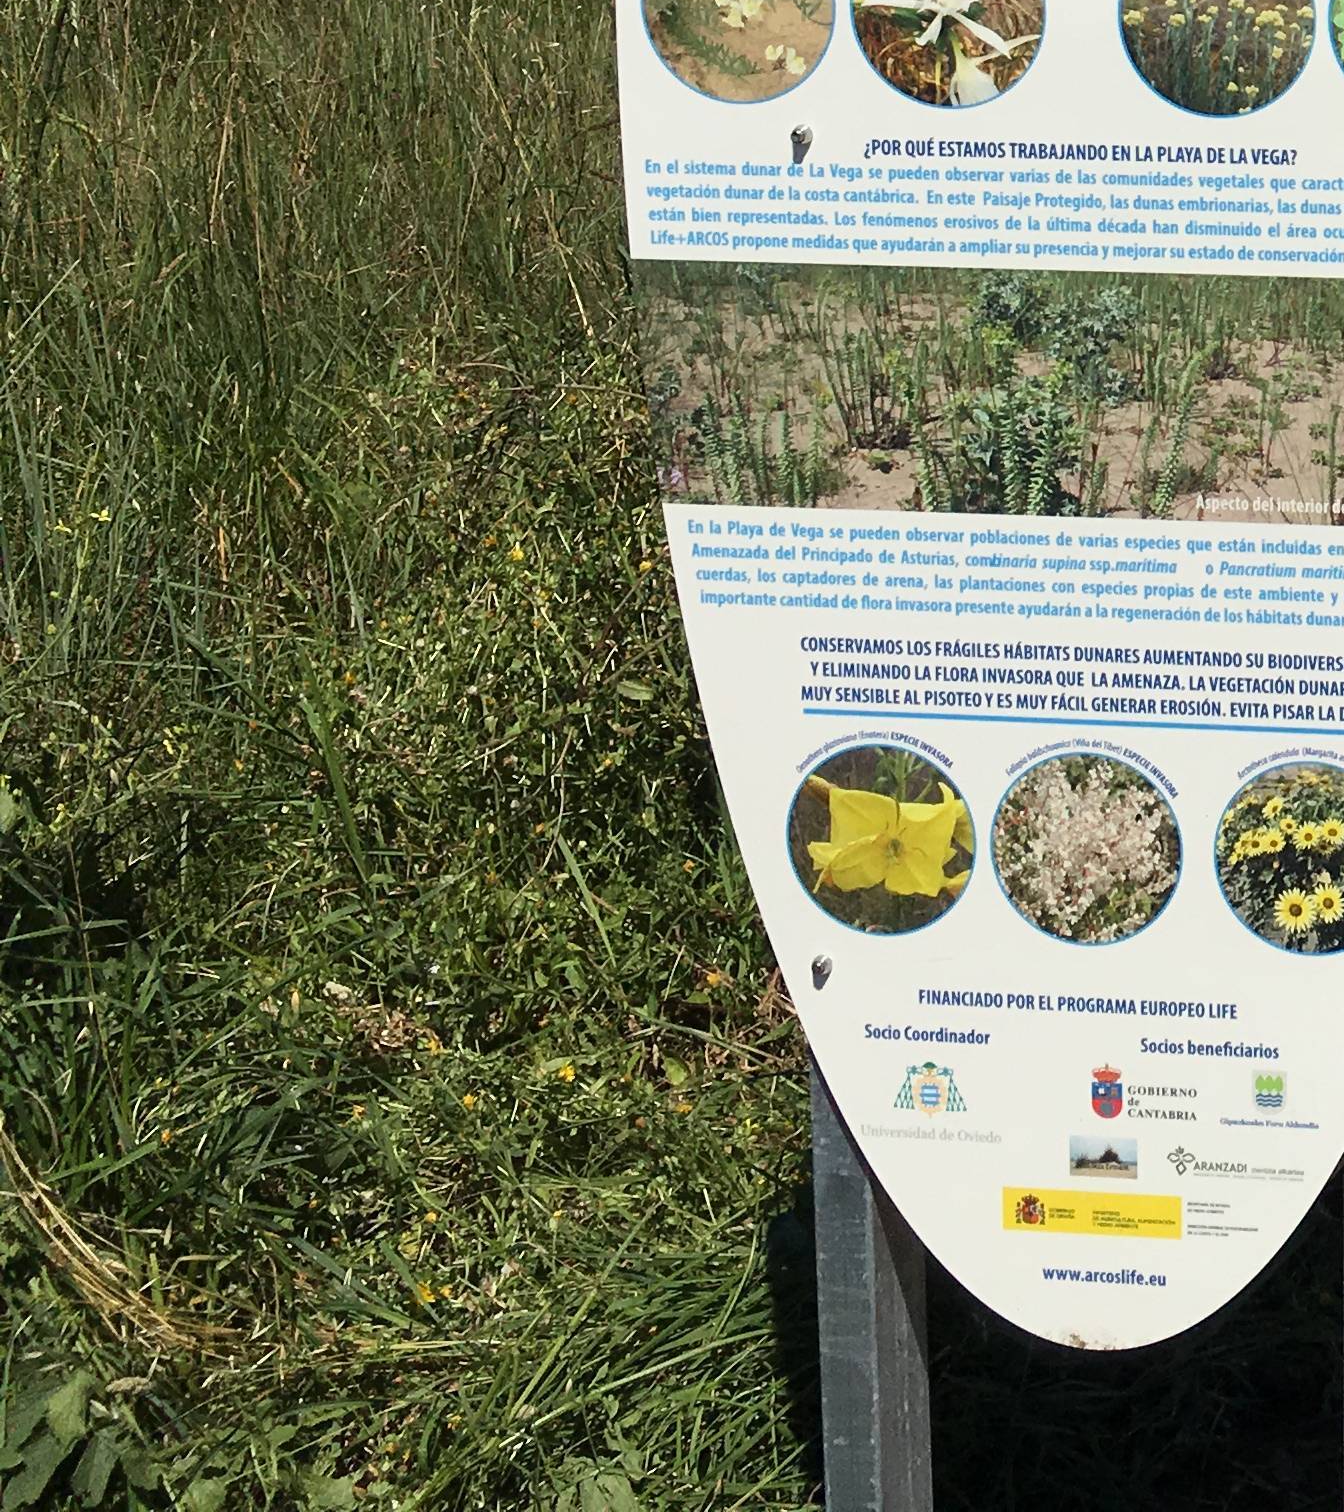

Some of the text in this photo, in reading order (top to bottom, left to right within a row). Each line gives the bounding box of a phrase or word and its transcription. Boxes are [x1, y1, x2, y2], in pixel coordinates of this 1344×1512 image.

[863, 139, 1297, 165] ¿POR QUÉ ESTAMOS TRABAJANDO EN LA PLAYA DE LA VEGA?
[1196, 494, 1250, 515] Aspecto
[1253, 495, 1275, 513] del
[1277, 496, 1330, 515] interior
[800, 637, 903, 654] CONSERVAMOS
[907, 640, 931, 656] LOS
[935, 641, 1000, 658] FRÁGILES
[1003, 643, 1070, 661] HÁBITATS
[1074, 646, 1140, 663] DUNARES
[1143, 649, 1242, 667] AUMENTANDO
[1245, 652, 1264, 668] SU
[918, 989, 1237, 1019] FINANCIADO POR EL PROGRAMA EUROPEO LIFE
[864, 1024, 990, 1044] Socio Coordinador
[1140, 1037, 1279, 1058] Socios beneficiarios
[1127, 1086, 1197, 1097] GOBIERNO
[1127, 1096, 1139, 1106] de
[1127, 1108, 1196, 1120] CANTABRIA
[860, 1124, 1002, 1144] Universidad de Oviedo
[1192, 1161, 1247, 1172] ARANZADI
[1042, 1268, 1166, 1286] www.arcoslife.eu
